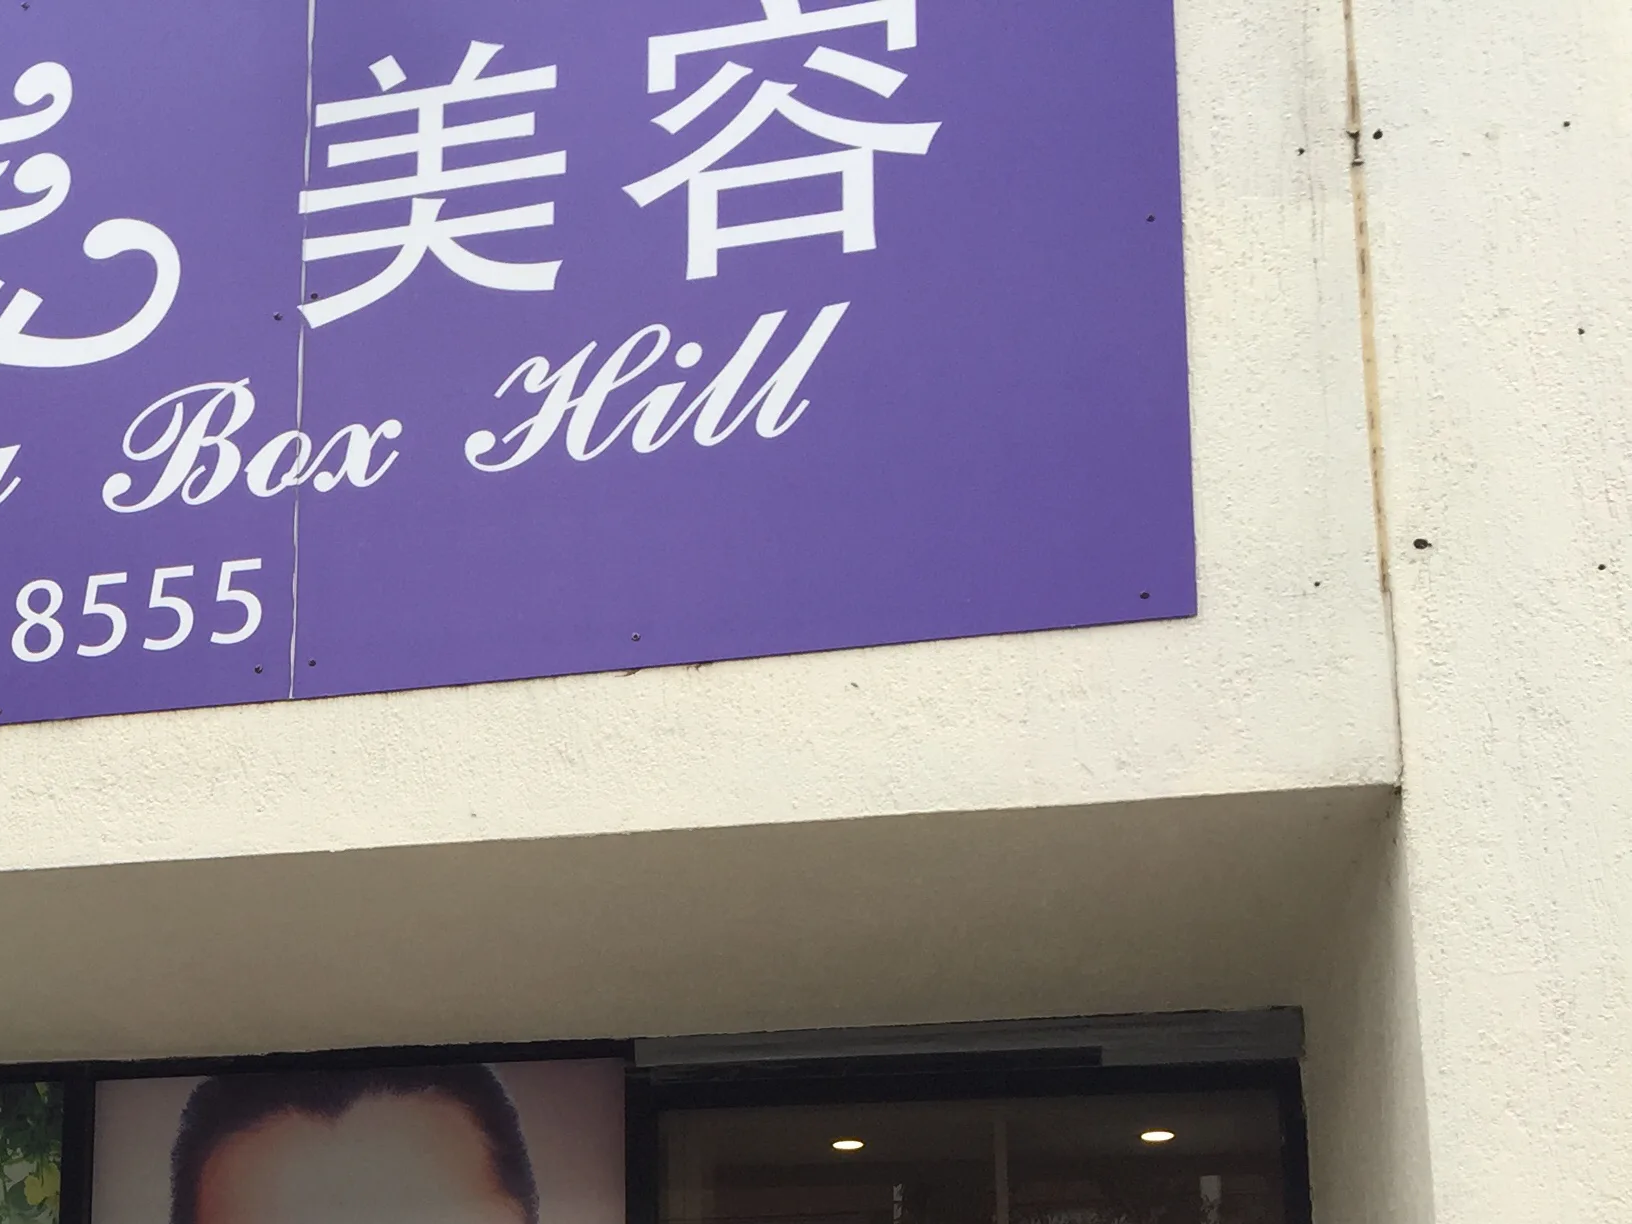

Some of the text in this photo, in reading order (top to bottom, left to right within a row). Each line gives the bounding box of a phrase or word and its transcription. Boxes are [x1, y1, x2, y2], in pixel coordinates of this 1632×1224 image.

[102, 377, 403, 513] Box
[464, 301, 851, 473] Hill
[11, 557, 262, 663] 8555
